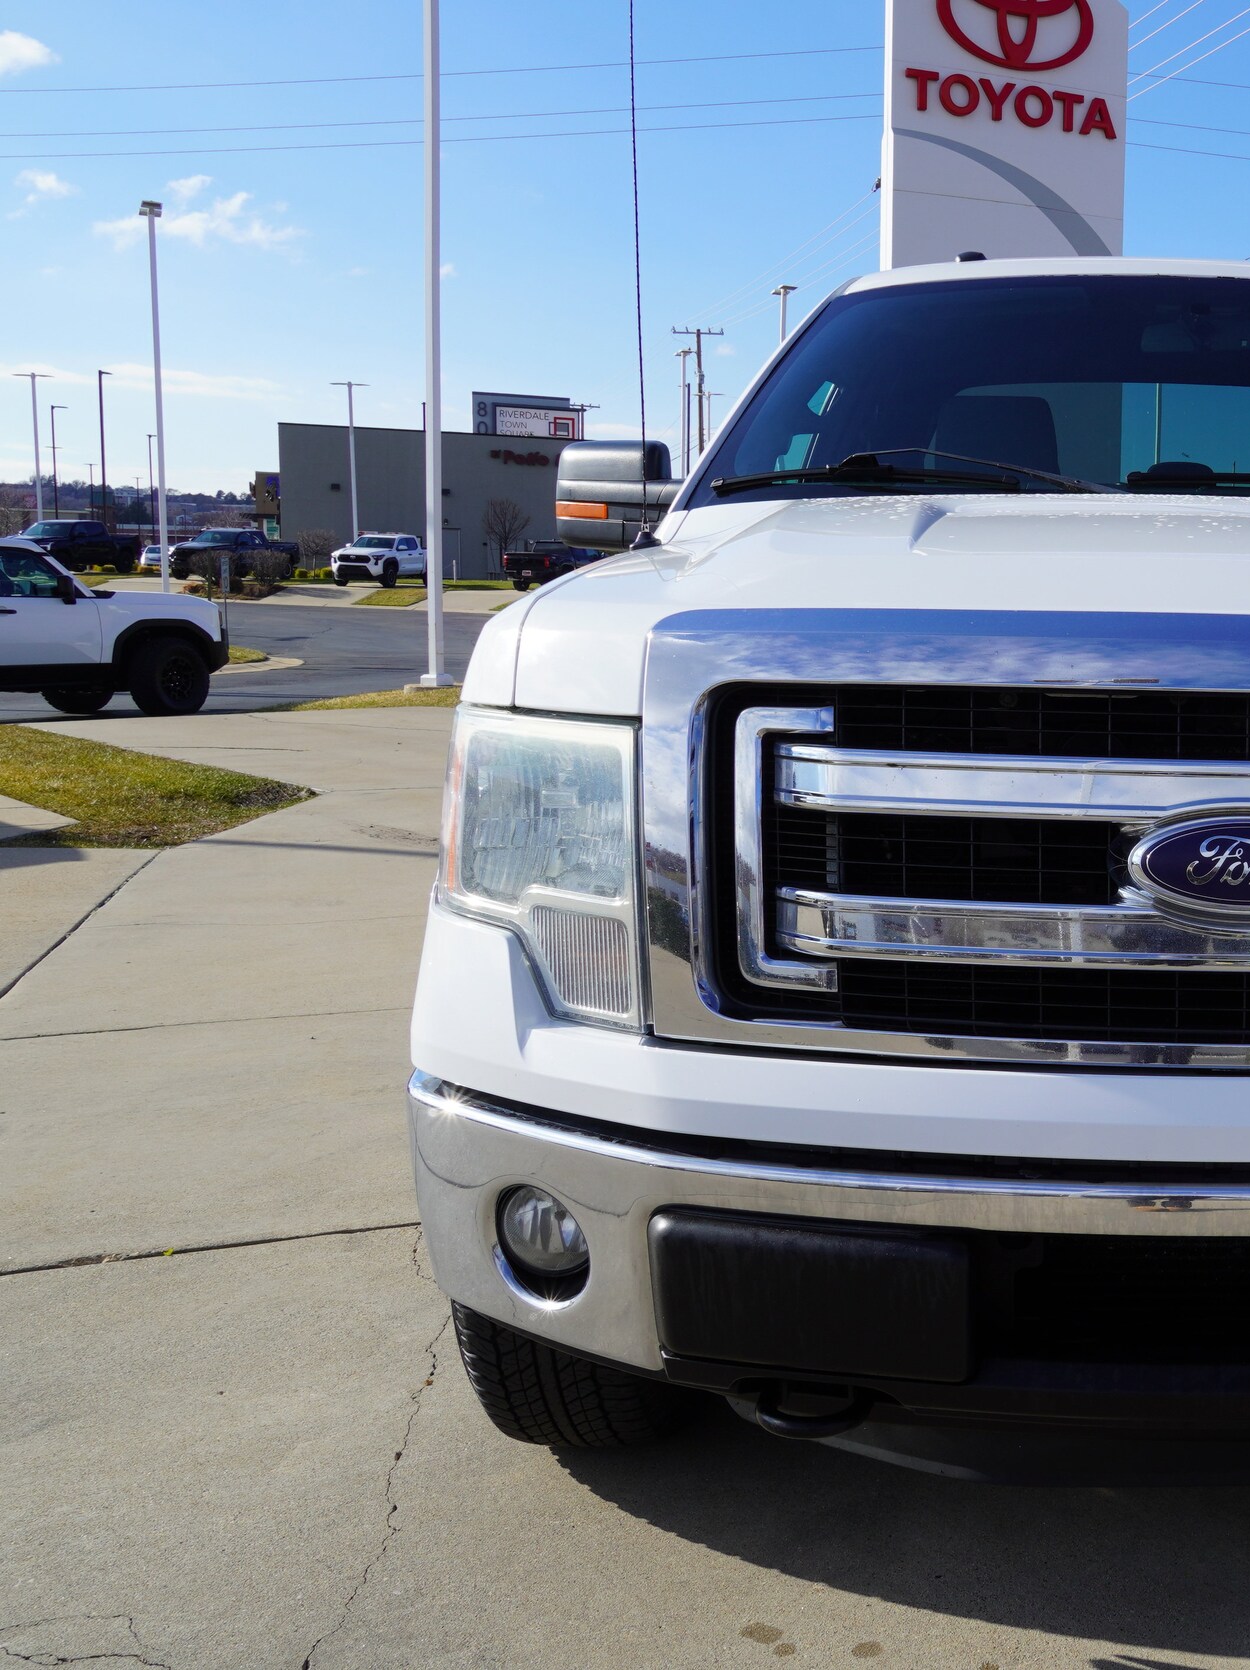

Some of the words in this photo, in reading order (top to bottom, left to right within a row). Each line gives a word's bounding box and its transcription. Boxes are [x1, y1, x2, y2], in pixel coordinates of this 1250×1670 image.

[905, 67, 1117, 140] TOYOTA
[499, 409, 550, 421] RIVERDALE
[500, 420, 528, 429] TOWN
